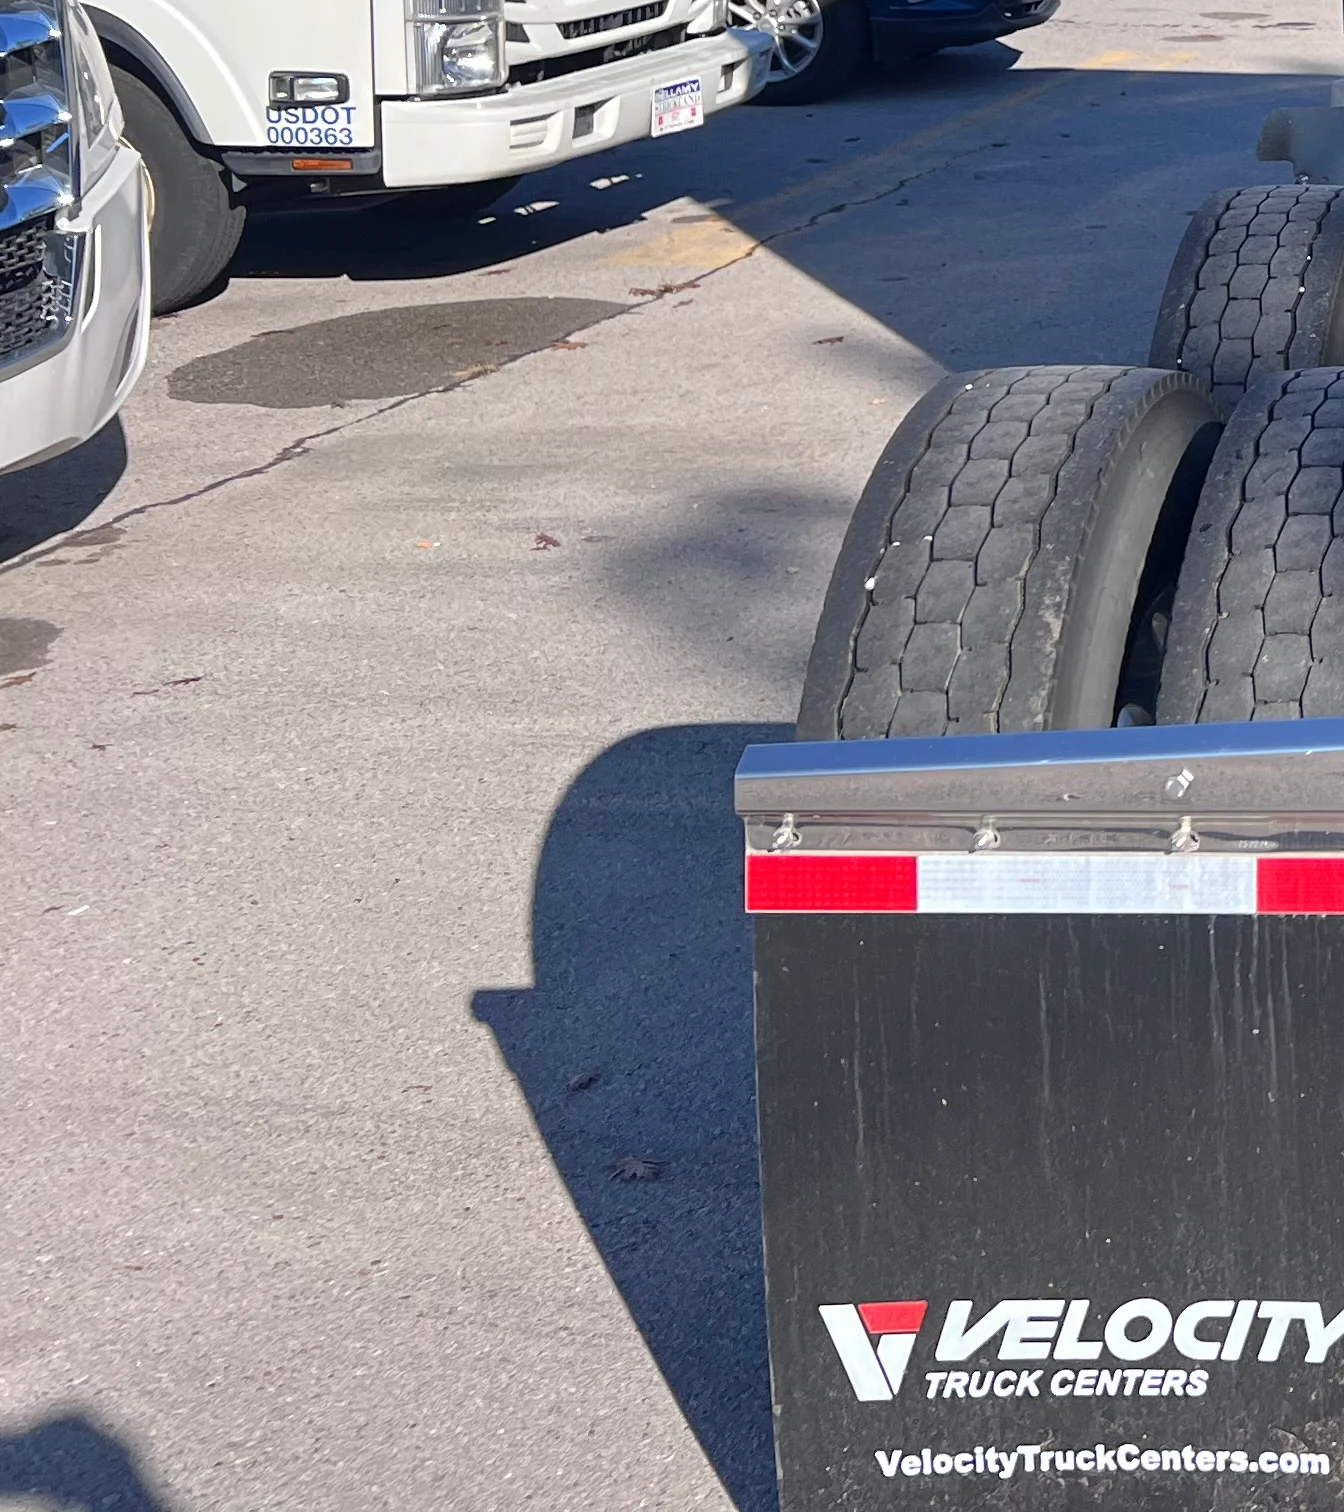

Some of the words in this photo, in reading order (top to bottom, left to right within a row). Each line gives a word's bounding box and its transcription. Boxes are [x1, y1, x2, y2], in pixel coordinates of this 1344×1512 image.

[265, 105, 357, 125] USDOT
[267, 126, 353, 145] 000363
[924, 1369, 1044, 1400] TRUCK
[1049, 1368, 1210, 1398] CENTERS
[874, 1443, 1331, 1479] VelocityTruckCenters.com
